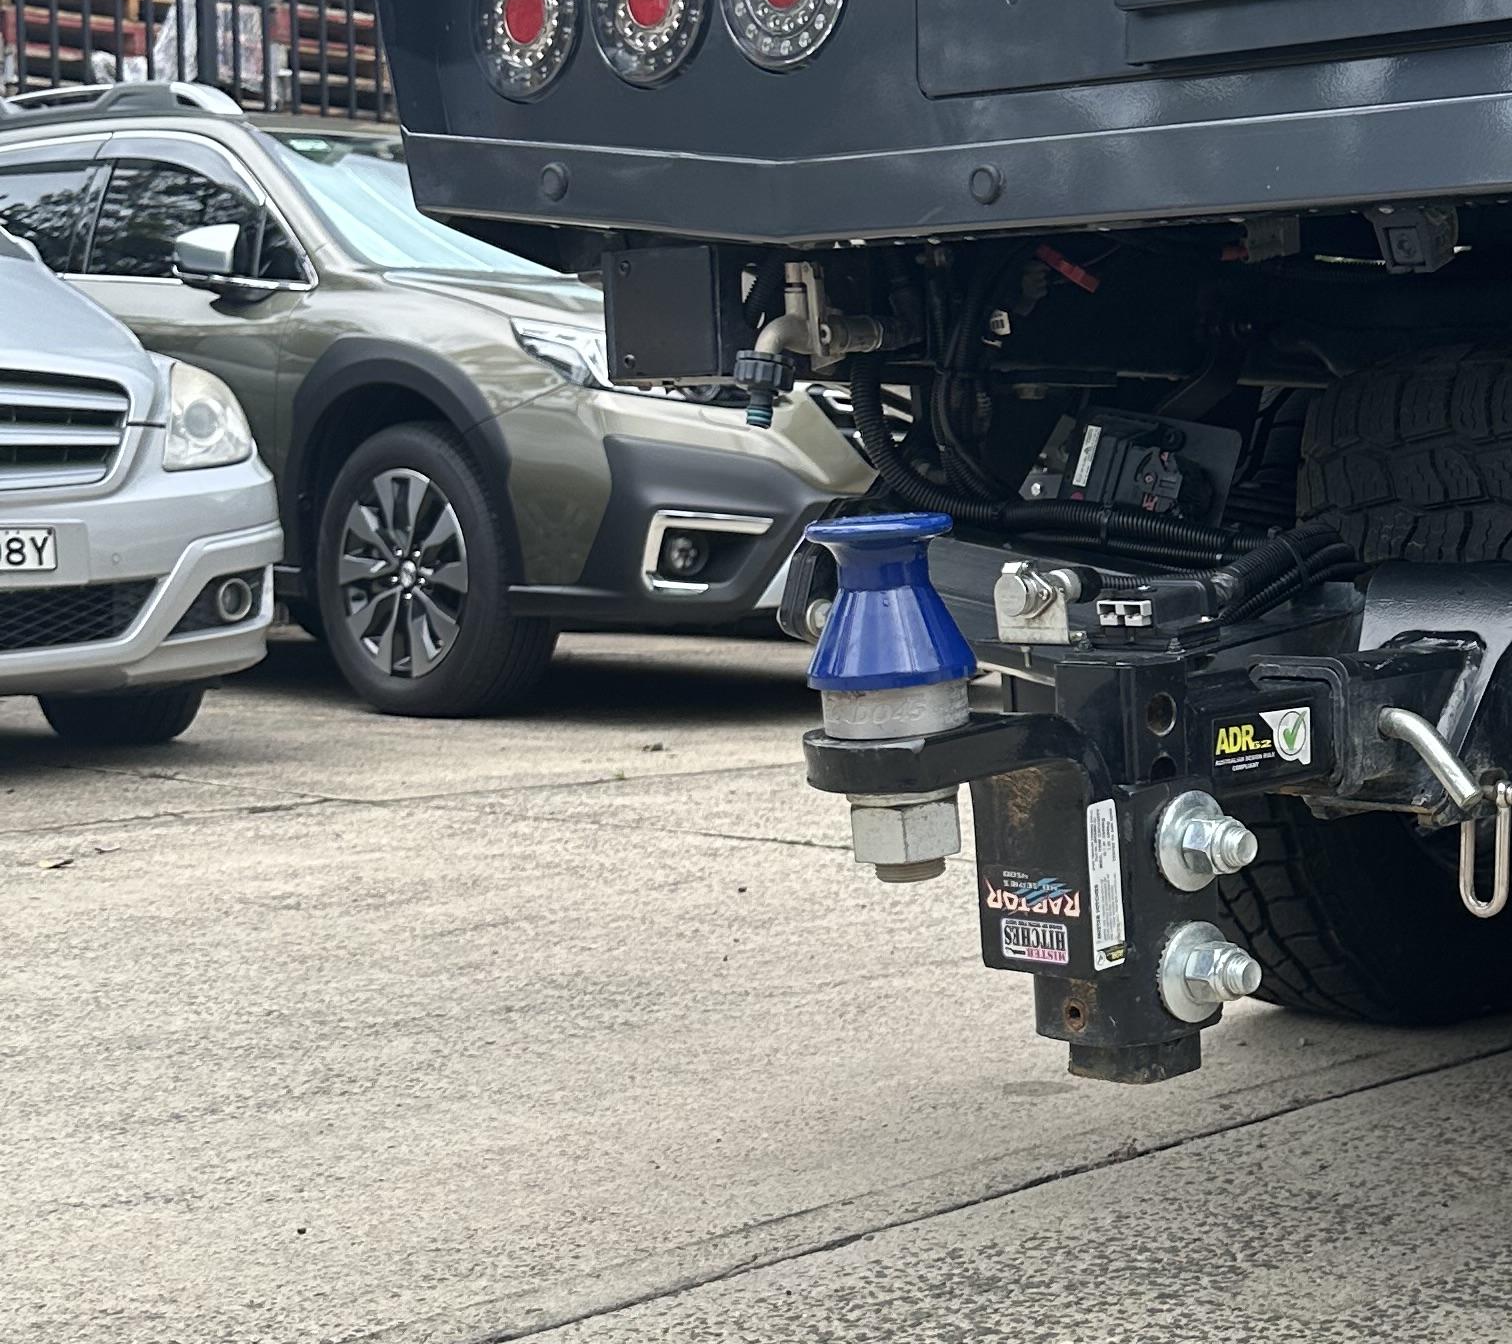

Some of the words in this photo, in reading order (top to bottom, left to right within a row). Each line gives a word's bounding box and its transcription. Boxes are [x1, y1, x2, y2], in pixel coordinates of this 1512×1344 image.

[0, 536, 48, 566] 8Y
[983, 875, 1081, 918] RAPTOR
[1003, 924, 1066, 951] HITCHES
[1026, 947, 1067, 962] MISTER
